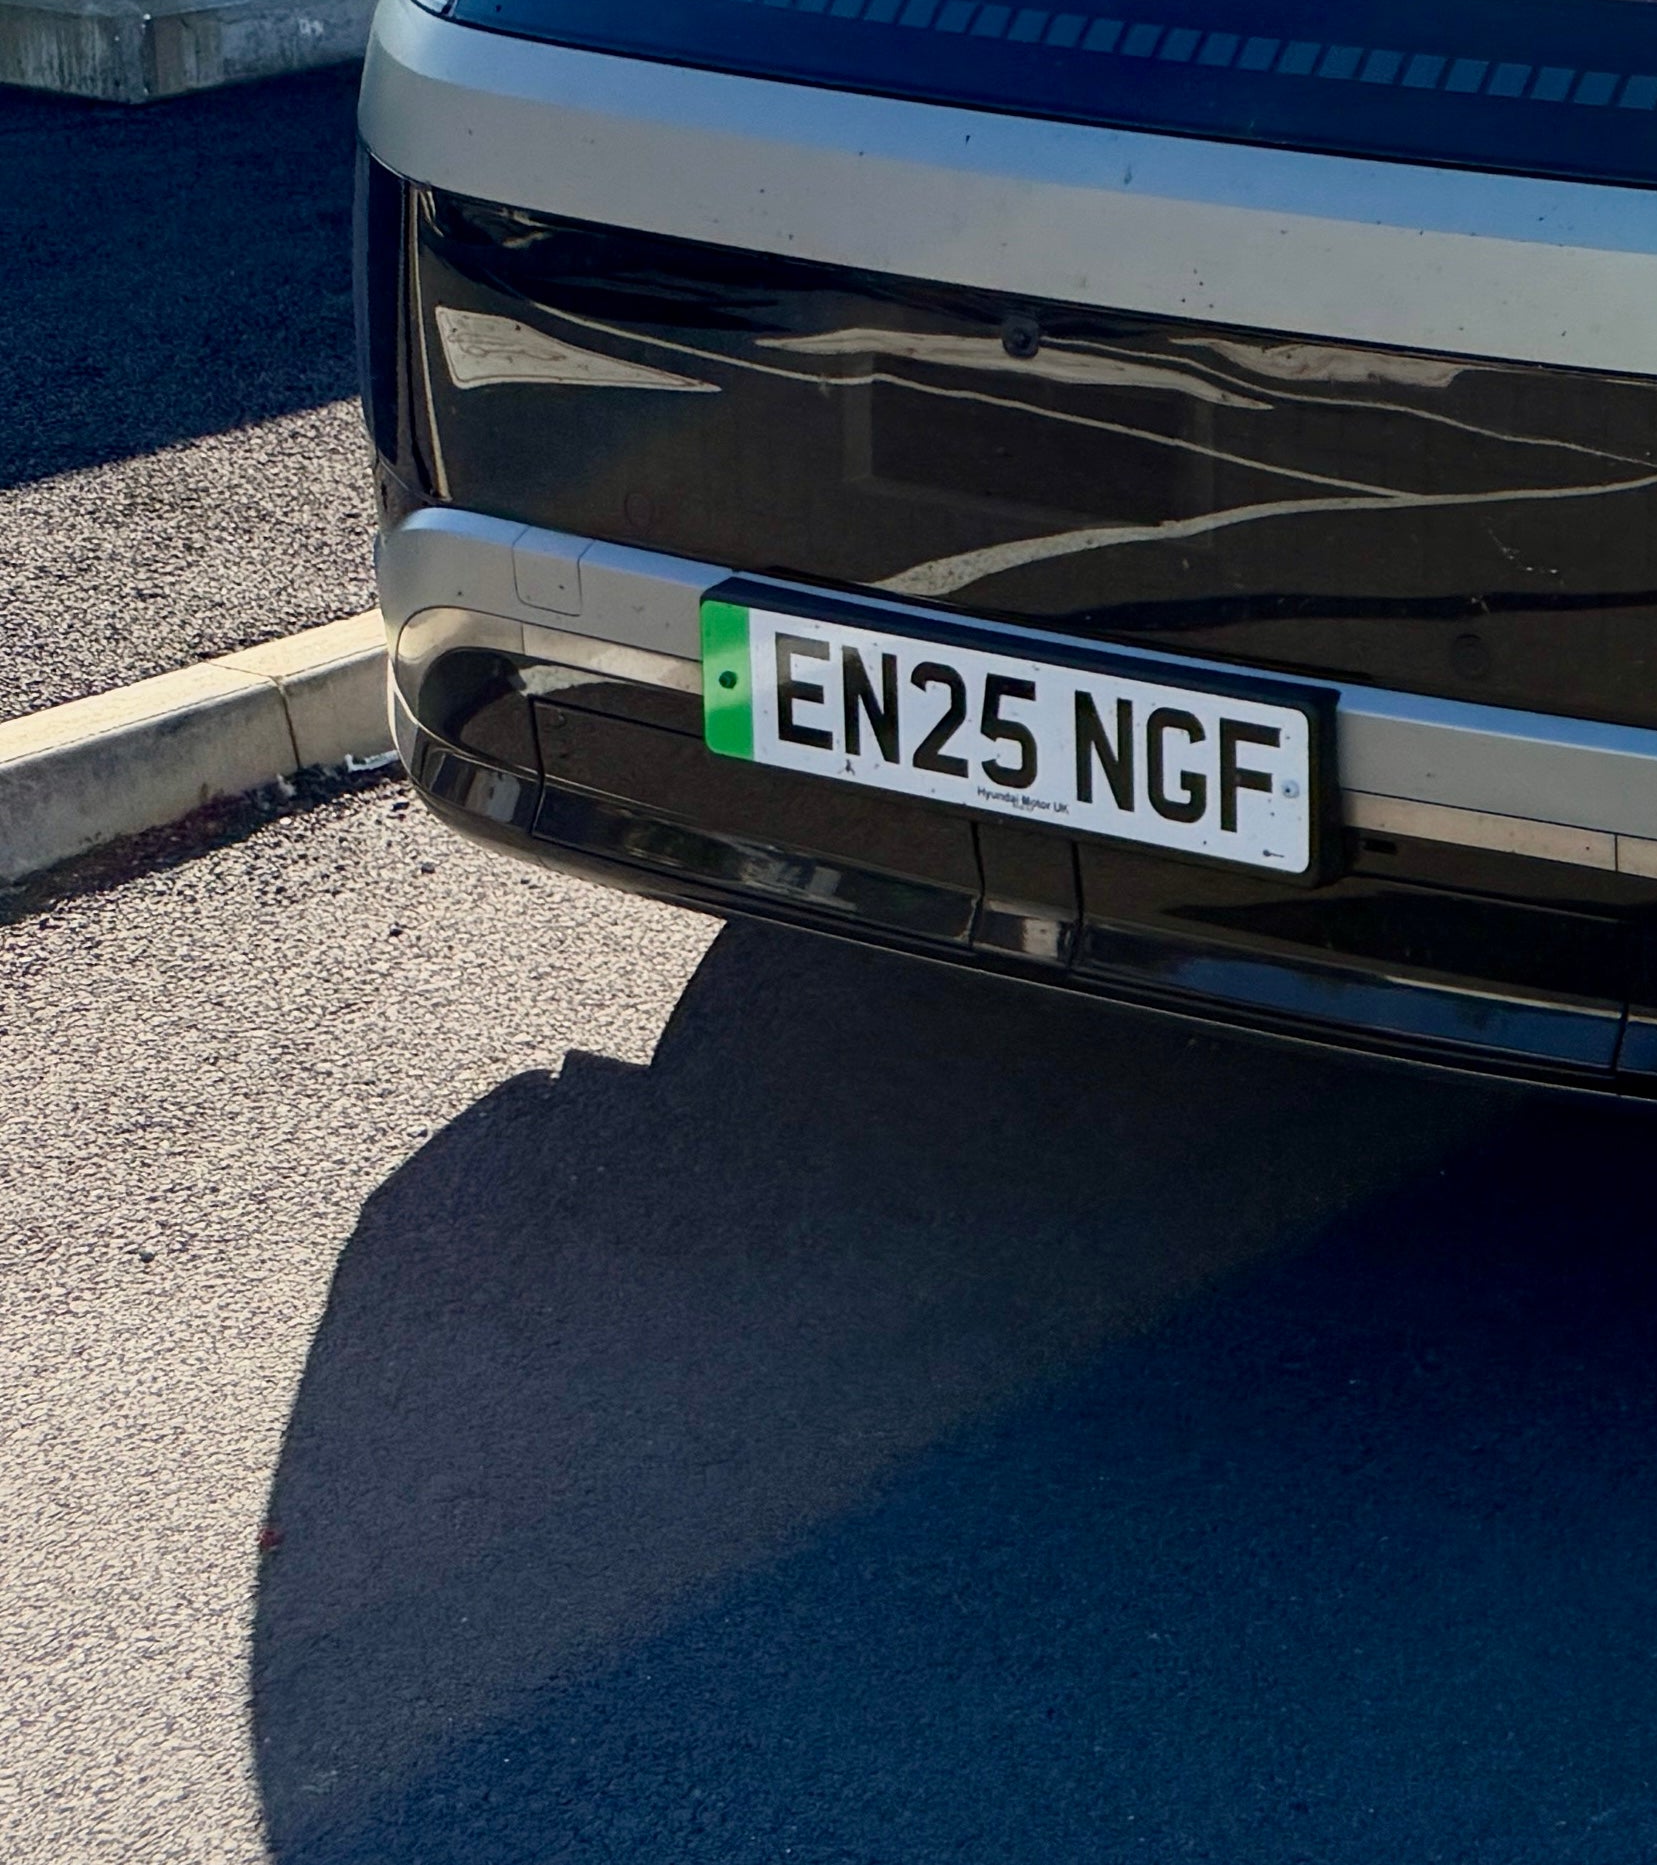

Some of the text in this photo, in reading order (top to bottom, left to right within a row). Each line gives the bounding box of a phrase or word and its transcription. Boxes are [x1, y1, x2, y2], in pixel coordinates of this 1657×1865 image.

[774, 632, 1282, 834] EN25 NGF
[977, 785, 1019, 806] Hyundai
[1022, 795, 1051, 809] Motor
[1053, 801, 1069, 815] UK
